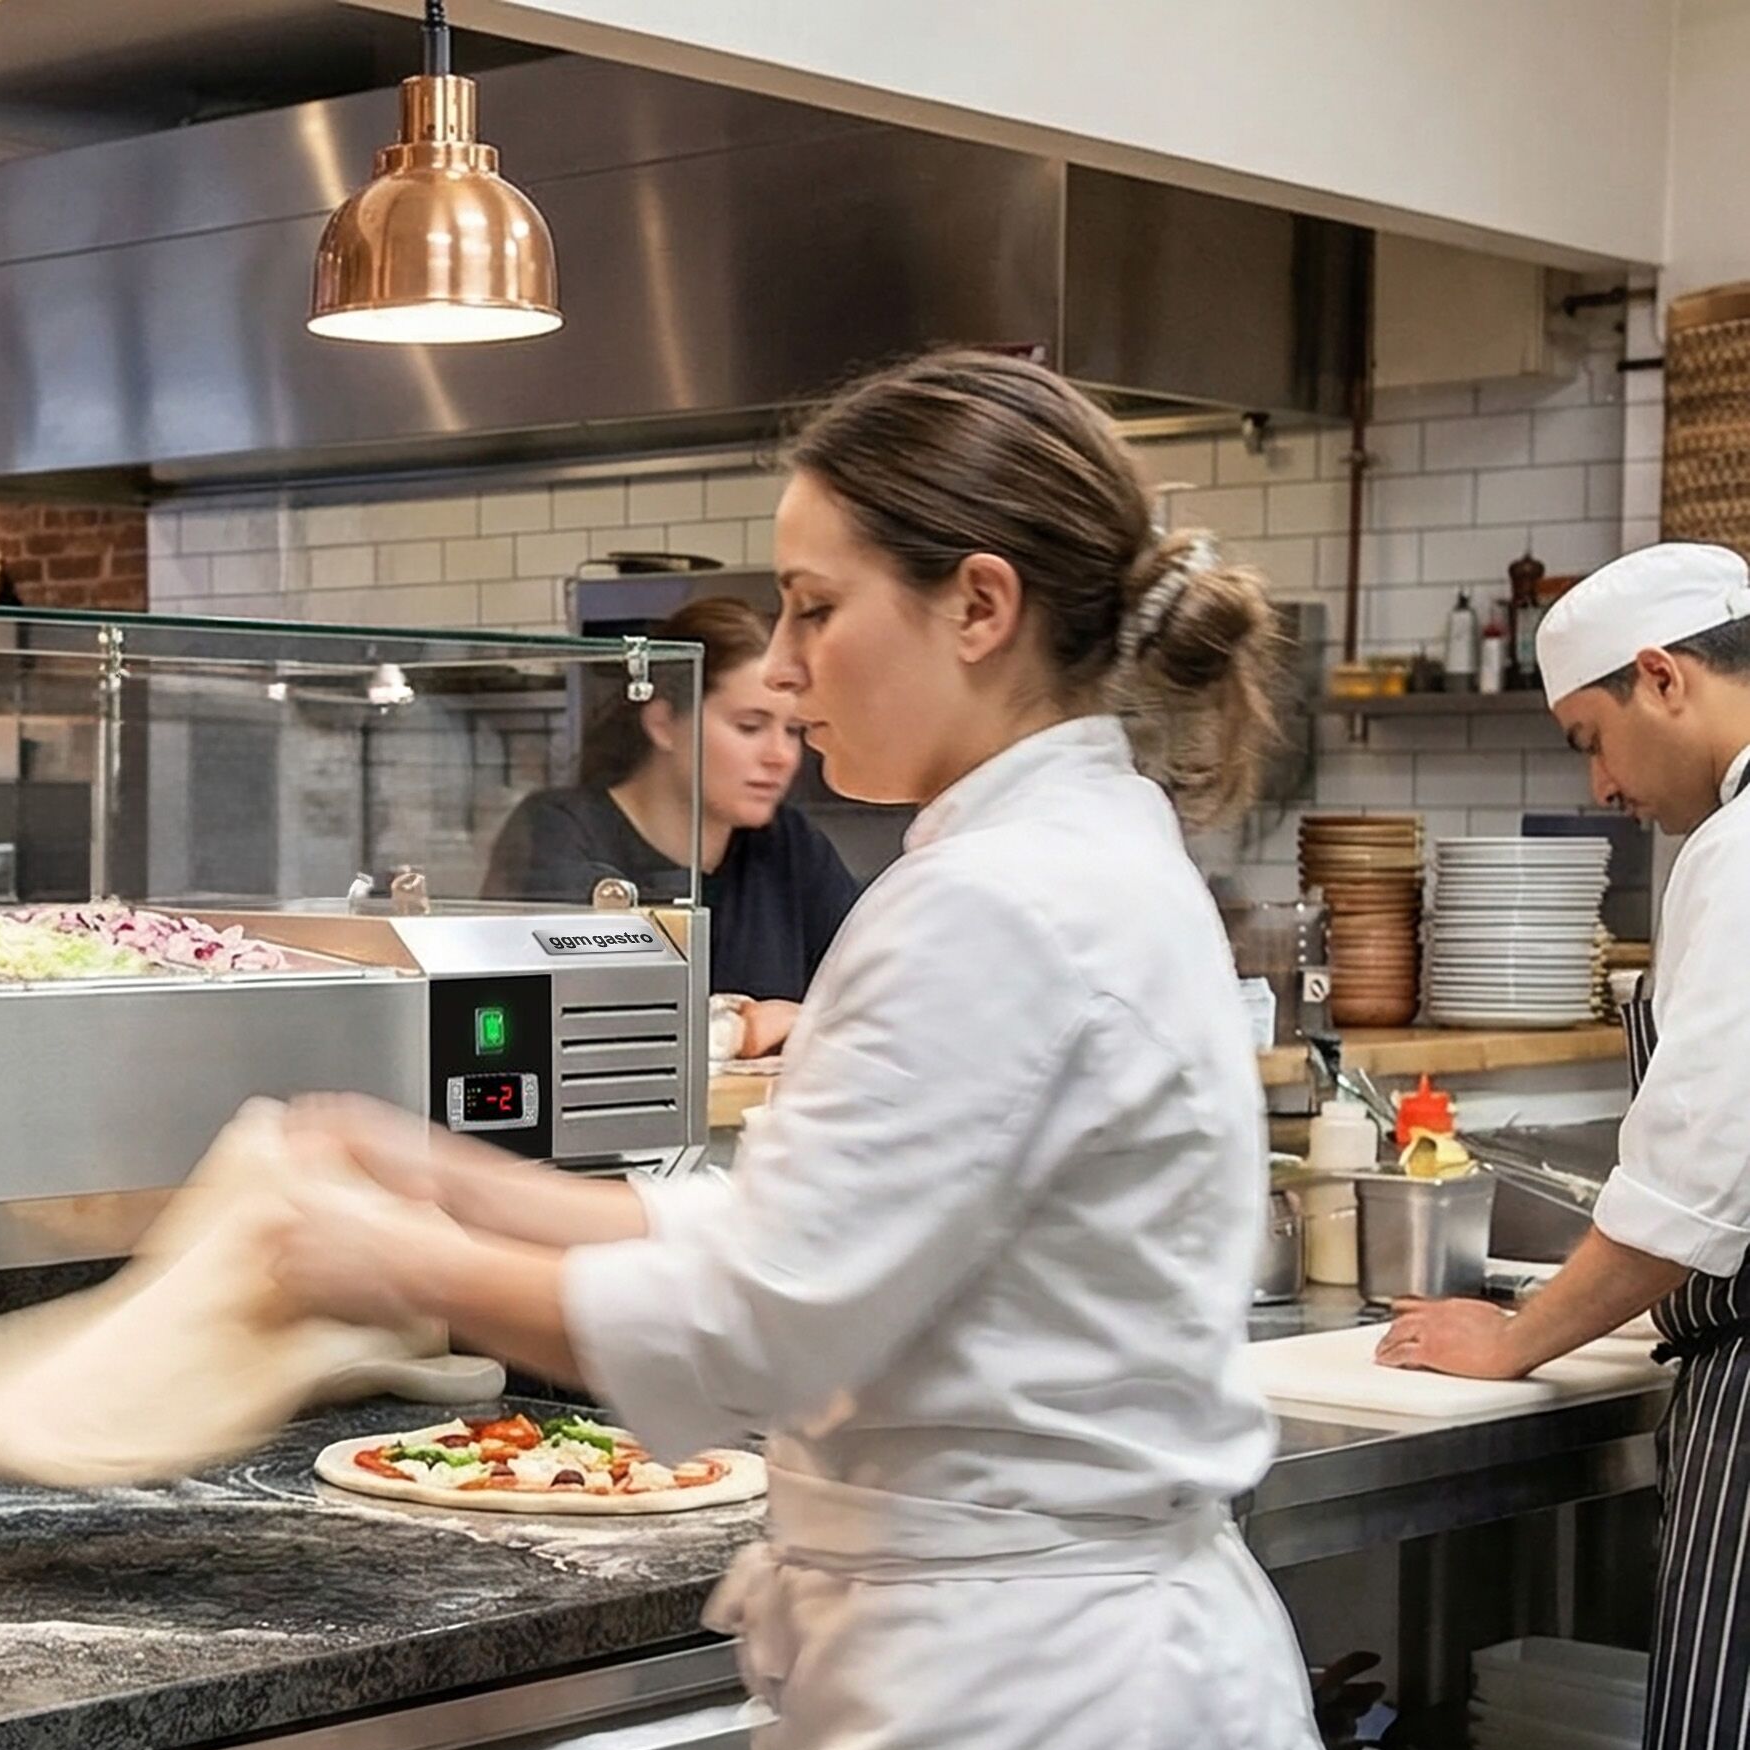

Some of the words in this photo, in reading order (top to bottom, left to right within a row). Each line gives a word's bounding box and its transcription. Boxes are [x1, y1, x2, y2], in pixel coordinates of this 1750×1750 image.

[549, 936, 592, 949] ggm
[592, 932, 654, 948] gastro
[486, 1085, 512, 1111] -2
